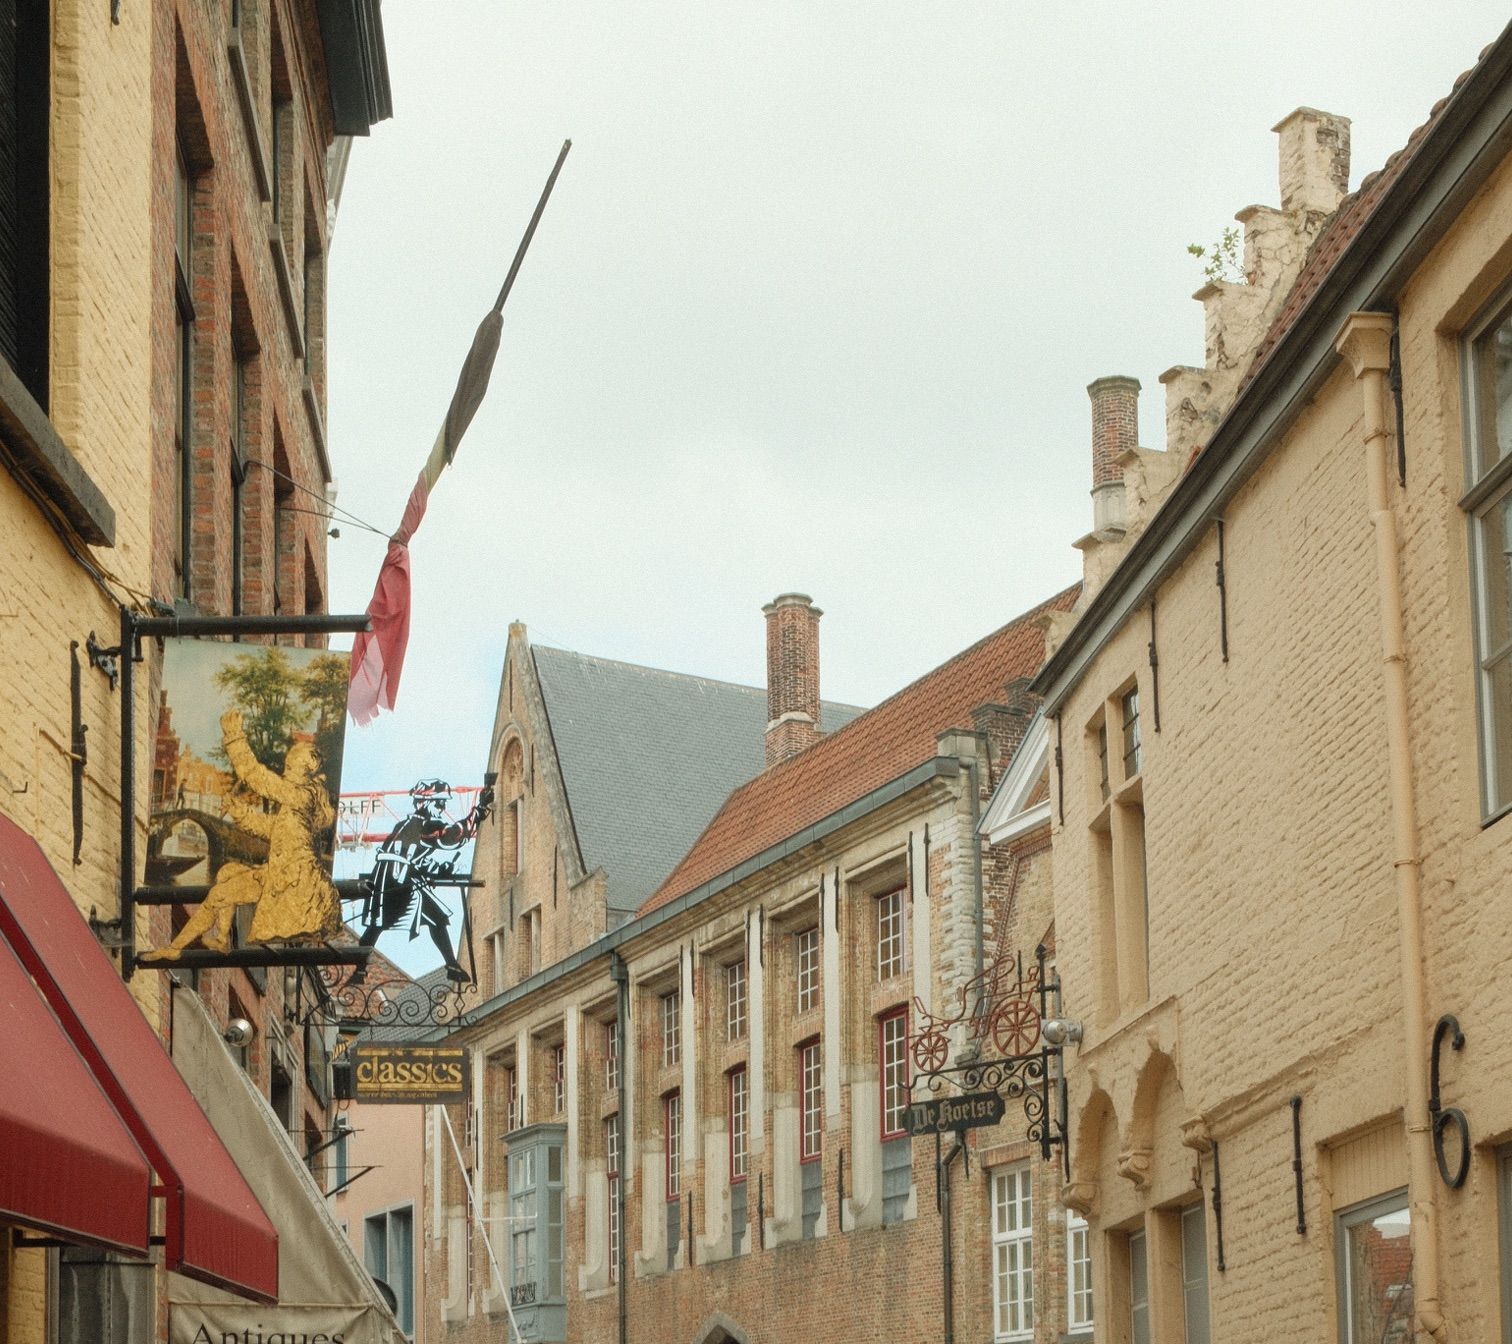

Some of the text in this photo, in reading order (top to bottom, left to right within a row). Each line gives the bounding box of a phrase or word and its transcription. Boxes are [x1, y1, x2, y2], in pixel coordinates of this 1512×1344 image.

[356, 1056, 463, 1083] classics
[911, 1098, 994, 1135] De Koetse
